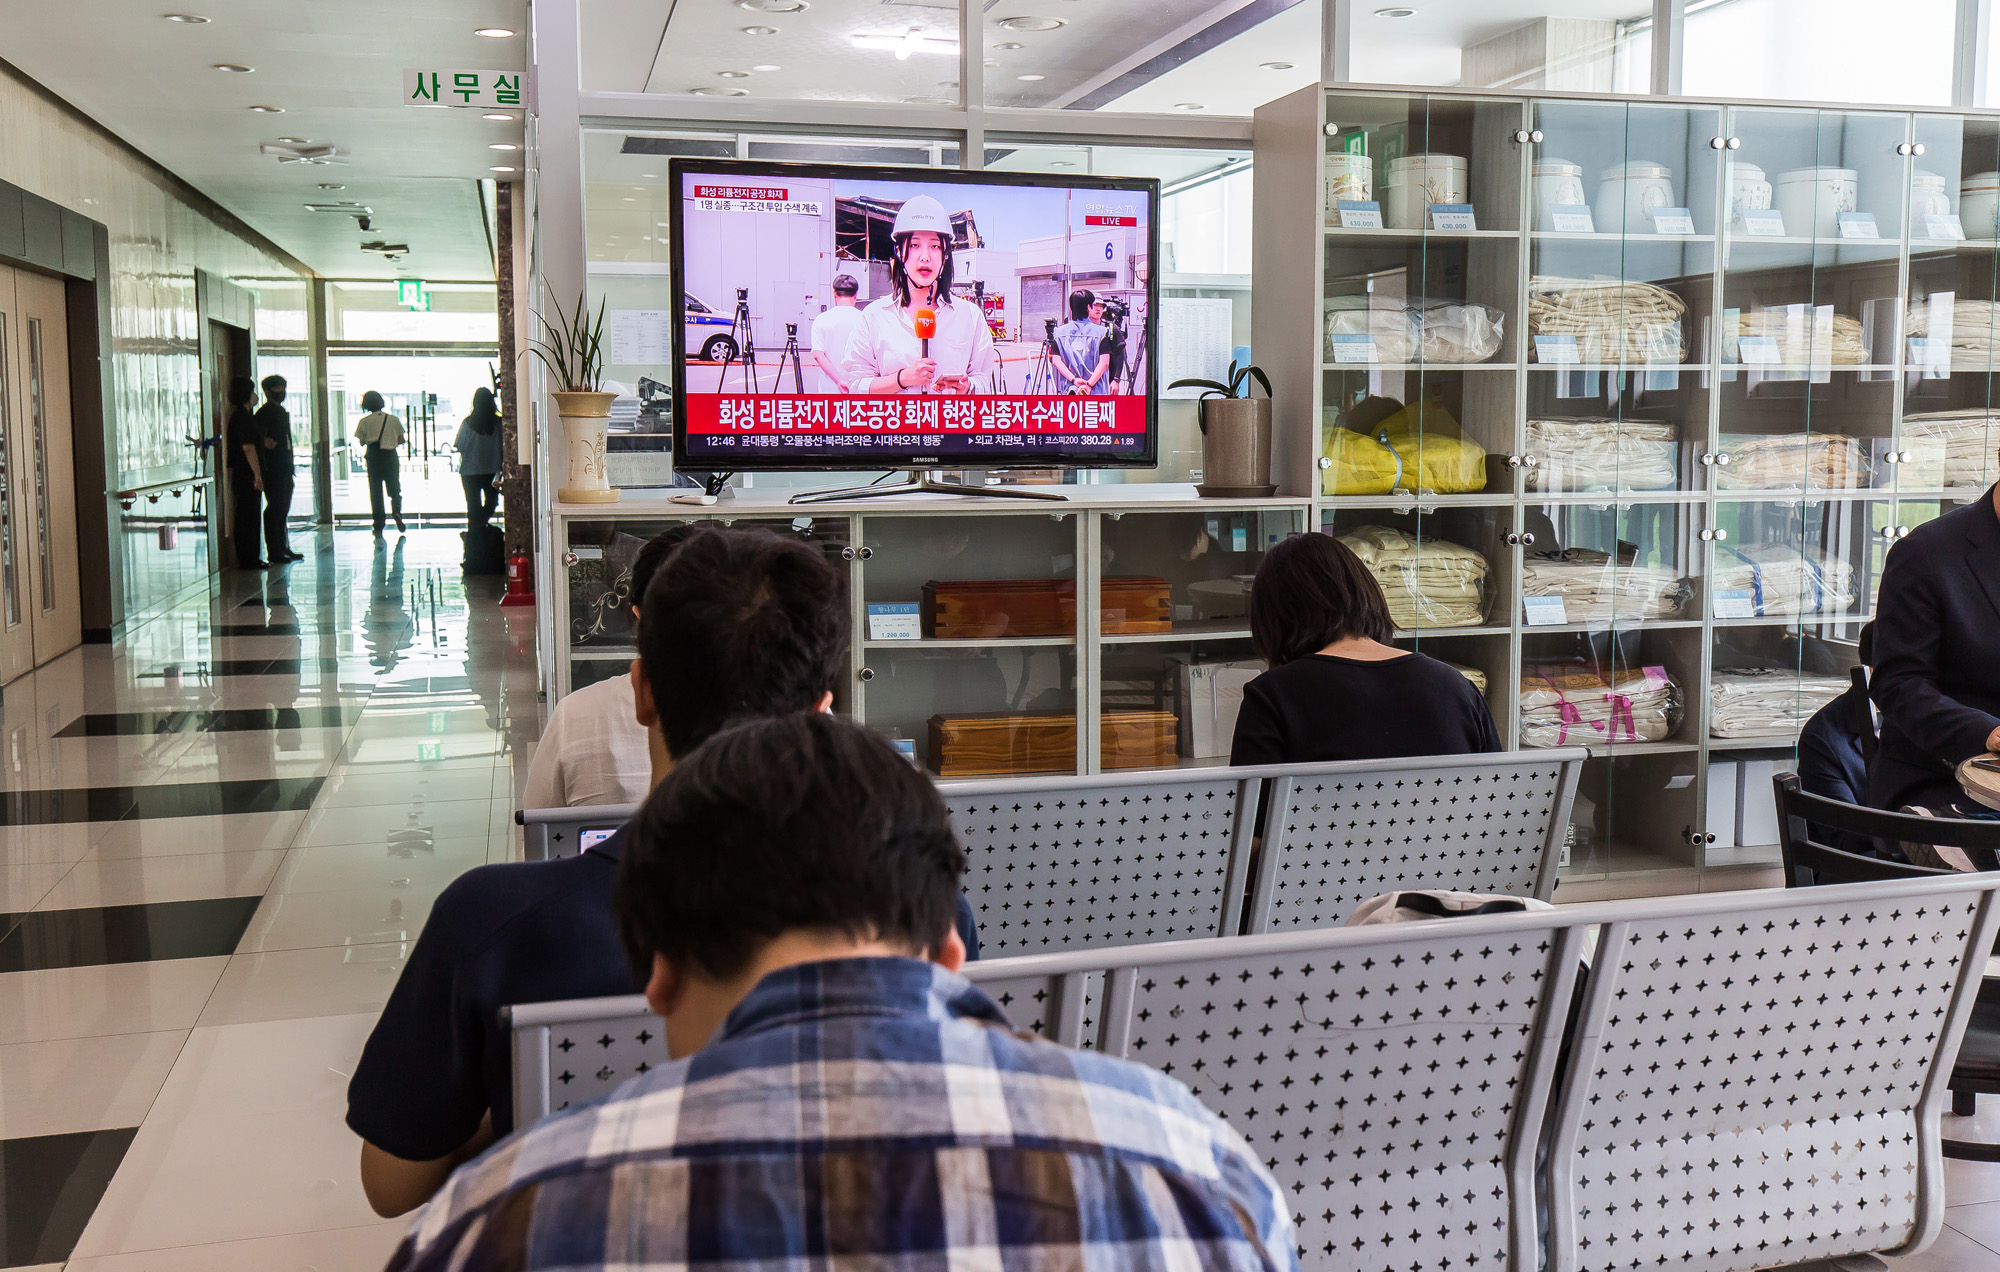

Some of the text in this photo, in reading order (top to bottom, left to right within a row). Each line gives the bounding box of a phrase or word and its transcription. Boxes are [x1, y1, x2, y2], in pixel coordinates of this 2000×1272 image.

[411, 72, 520, 105] 사무실
[700, 187, 784, 200] 화성 리튬전지 공장 화재
[700, 201, 713, 210] 1명
[766, 202, 783, 213] 투입
[784, 203, 801, 213] 수색
[802, 203, 819, 214] 계속
[1101, 217, 1121, 226] LIVE
[1105, 242, 1113, 260] 6
[965, 261, 971, 276] 7
[718, 399, 1116, 430] 화성 리튬전지 제조공장 화재 현장 실종자 수색 이틀째
[706, 436, 735, 446] 12:46
[741, 435, 779, 447] 윤대통령
[874, 435, 920, 447] 시대착오적
[975, 435, 993, 446] 외교
[1027, 435, 1036, 446] 러
[1045, 436, 1078, 445] 코스피200
[1081, 435, 1112, 445] 380.28
